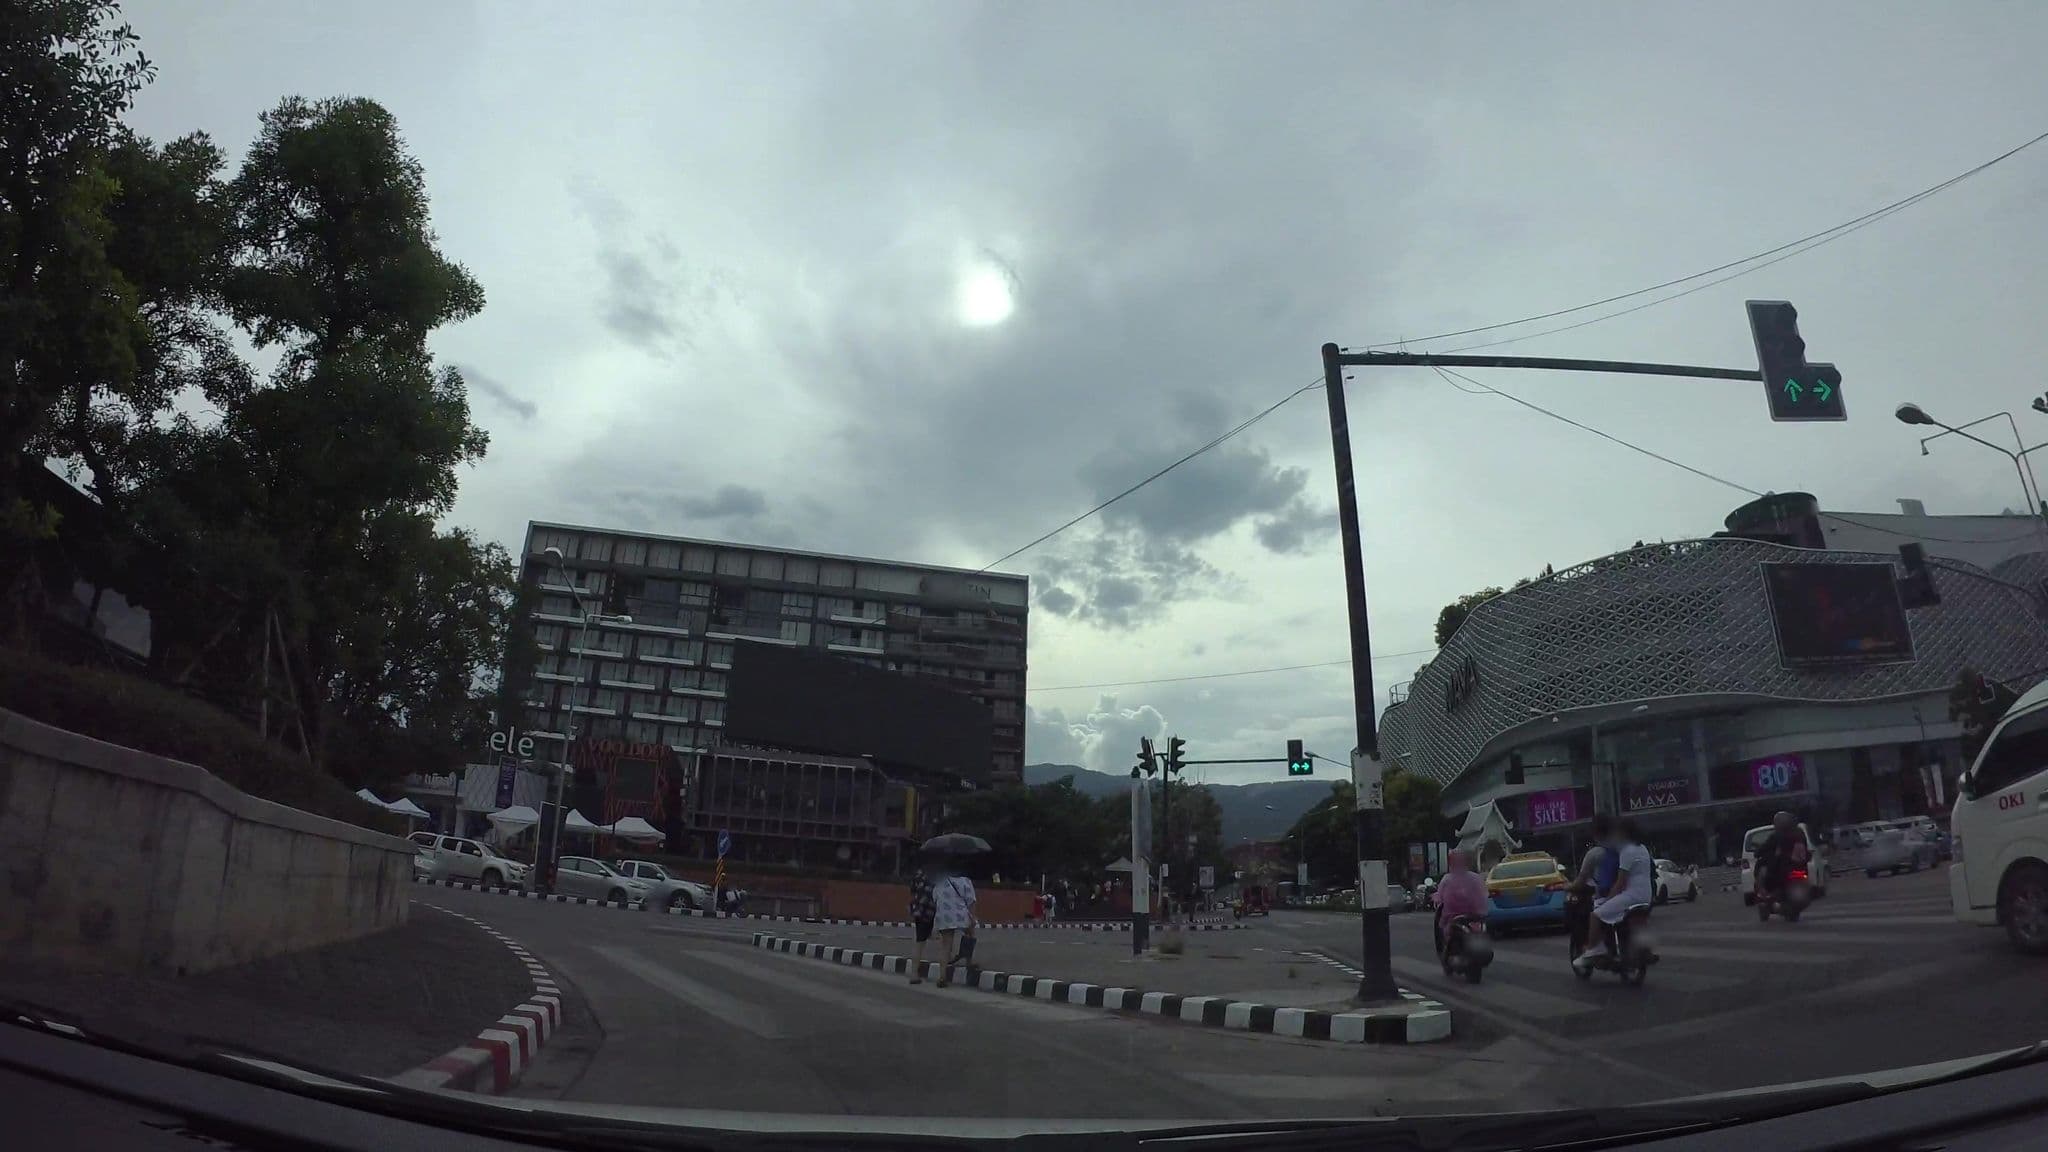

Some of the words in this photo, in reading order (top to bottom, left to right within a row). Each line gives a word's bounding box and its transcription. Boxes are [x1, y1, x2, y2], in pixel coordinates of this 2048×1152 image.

[490, 726, 534, 757] ele
[1630, 791, 1678, 810] MAYA
[1999, 791, 2025, 811] OKI
[1535, 808, 1568, 825] SALE
